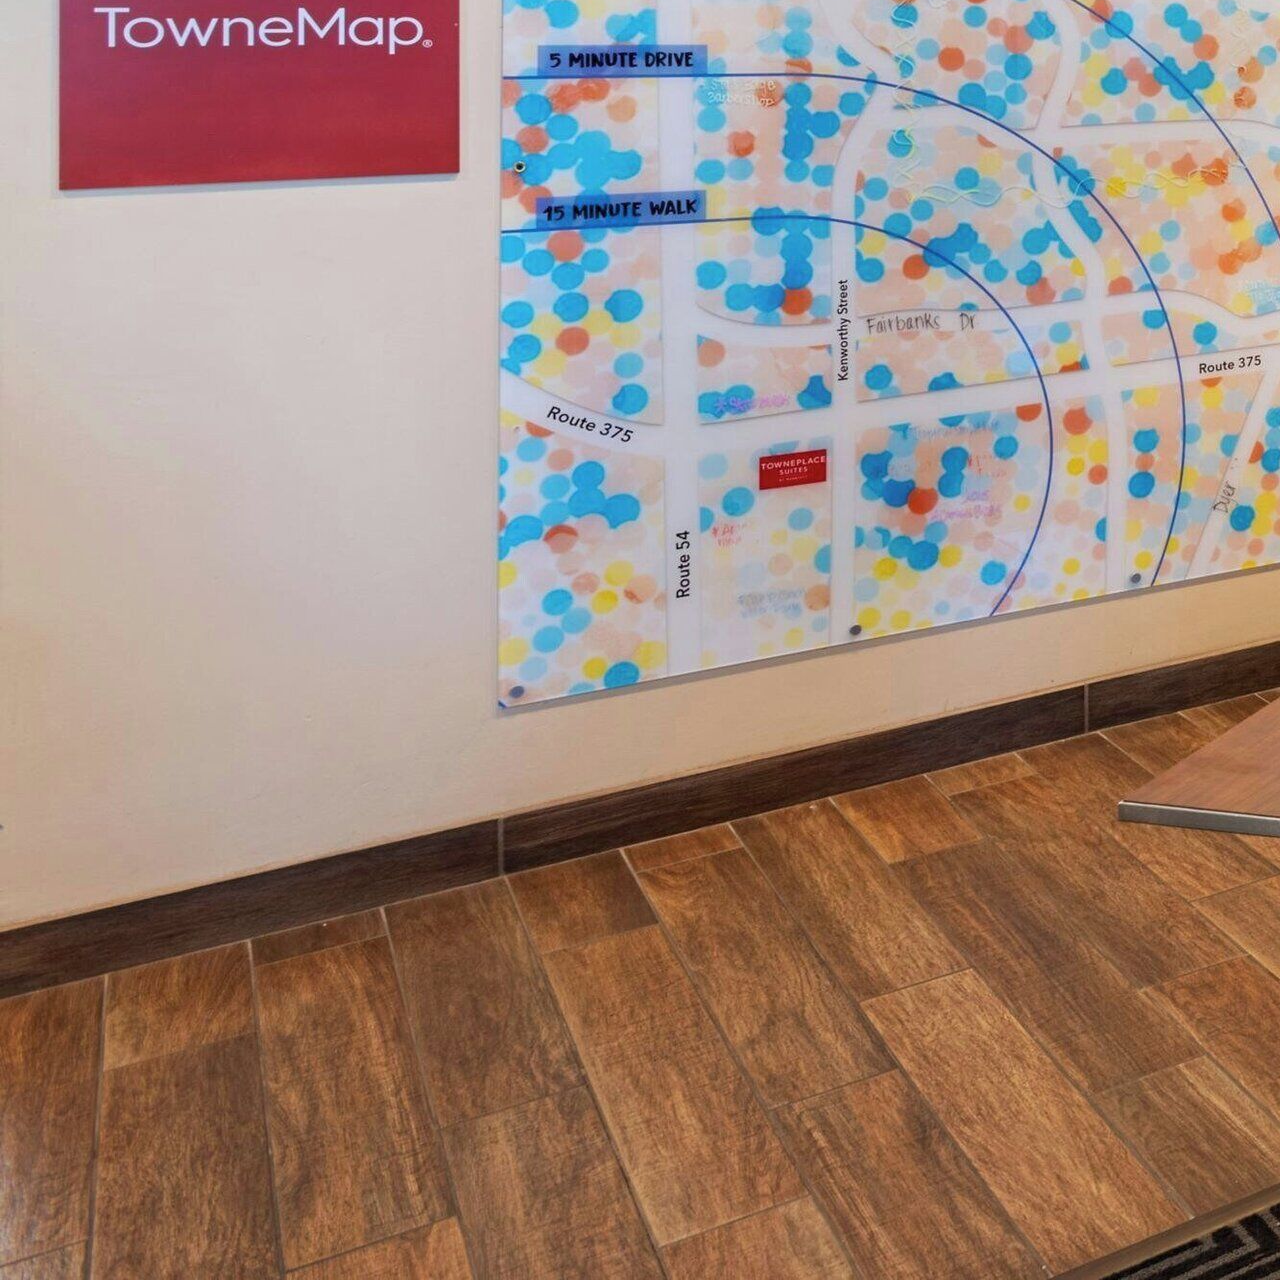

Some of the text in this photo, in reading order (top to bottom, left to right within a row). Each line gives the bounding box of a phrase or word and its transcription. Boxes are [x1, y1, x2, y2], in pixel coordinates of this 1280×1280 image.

[549, 51, 694, 68] 5 MINUTE DRIVE
[543, 199, 698, 221] 15 MINUTE WALK
[837, 280, 851, 381] Kenworthy Street
[866, 312, 941, 335] Fairbanks
[1199, 355, 1262, 374] Route 375
[546, 406, 634, 444] Route 375
[761, 455, 826, 470] TOWNEPLACE
[779, 466, 808, 476] SUITES
[1211, 480, 1239, 513] Dyer
[676, 531, 690, 599] Route 54
